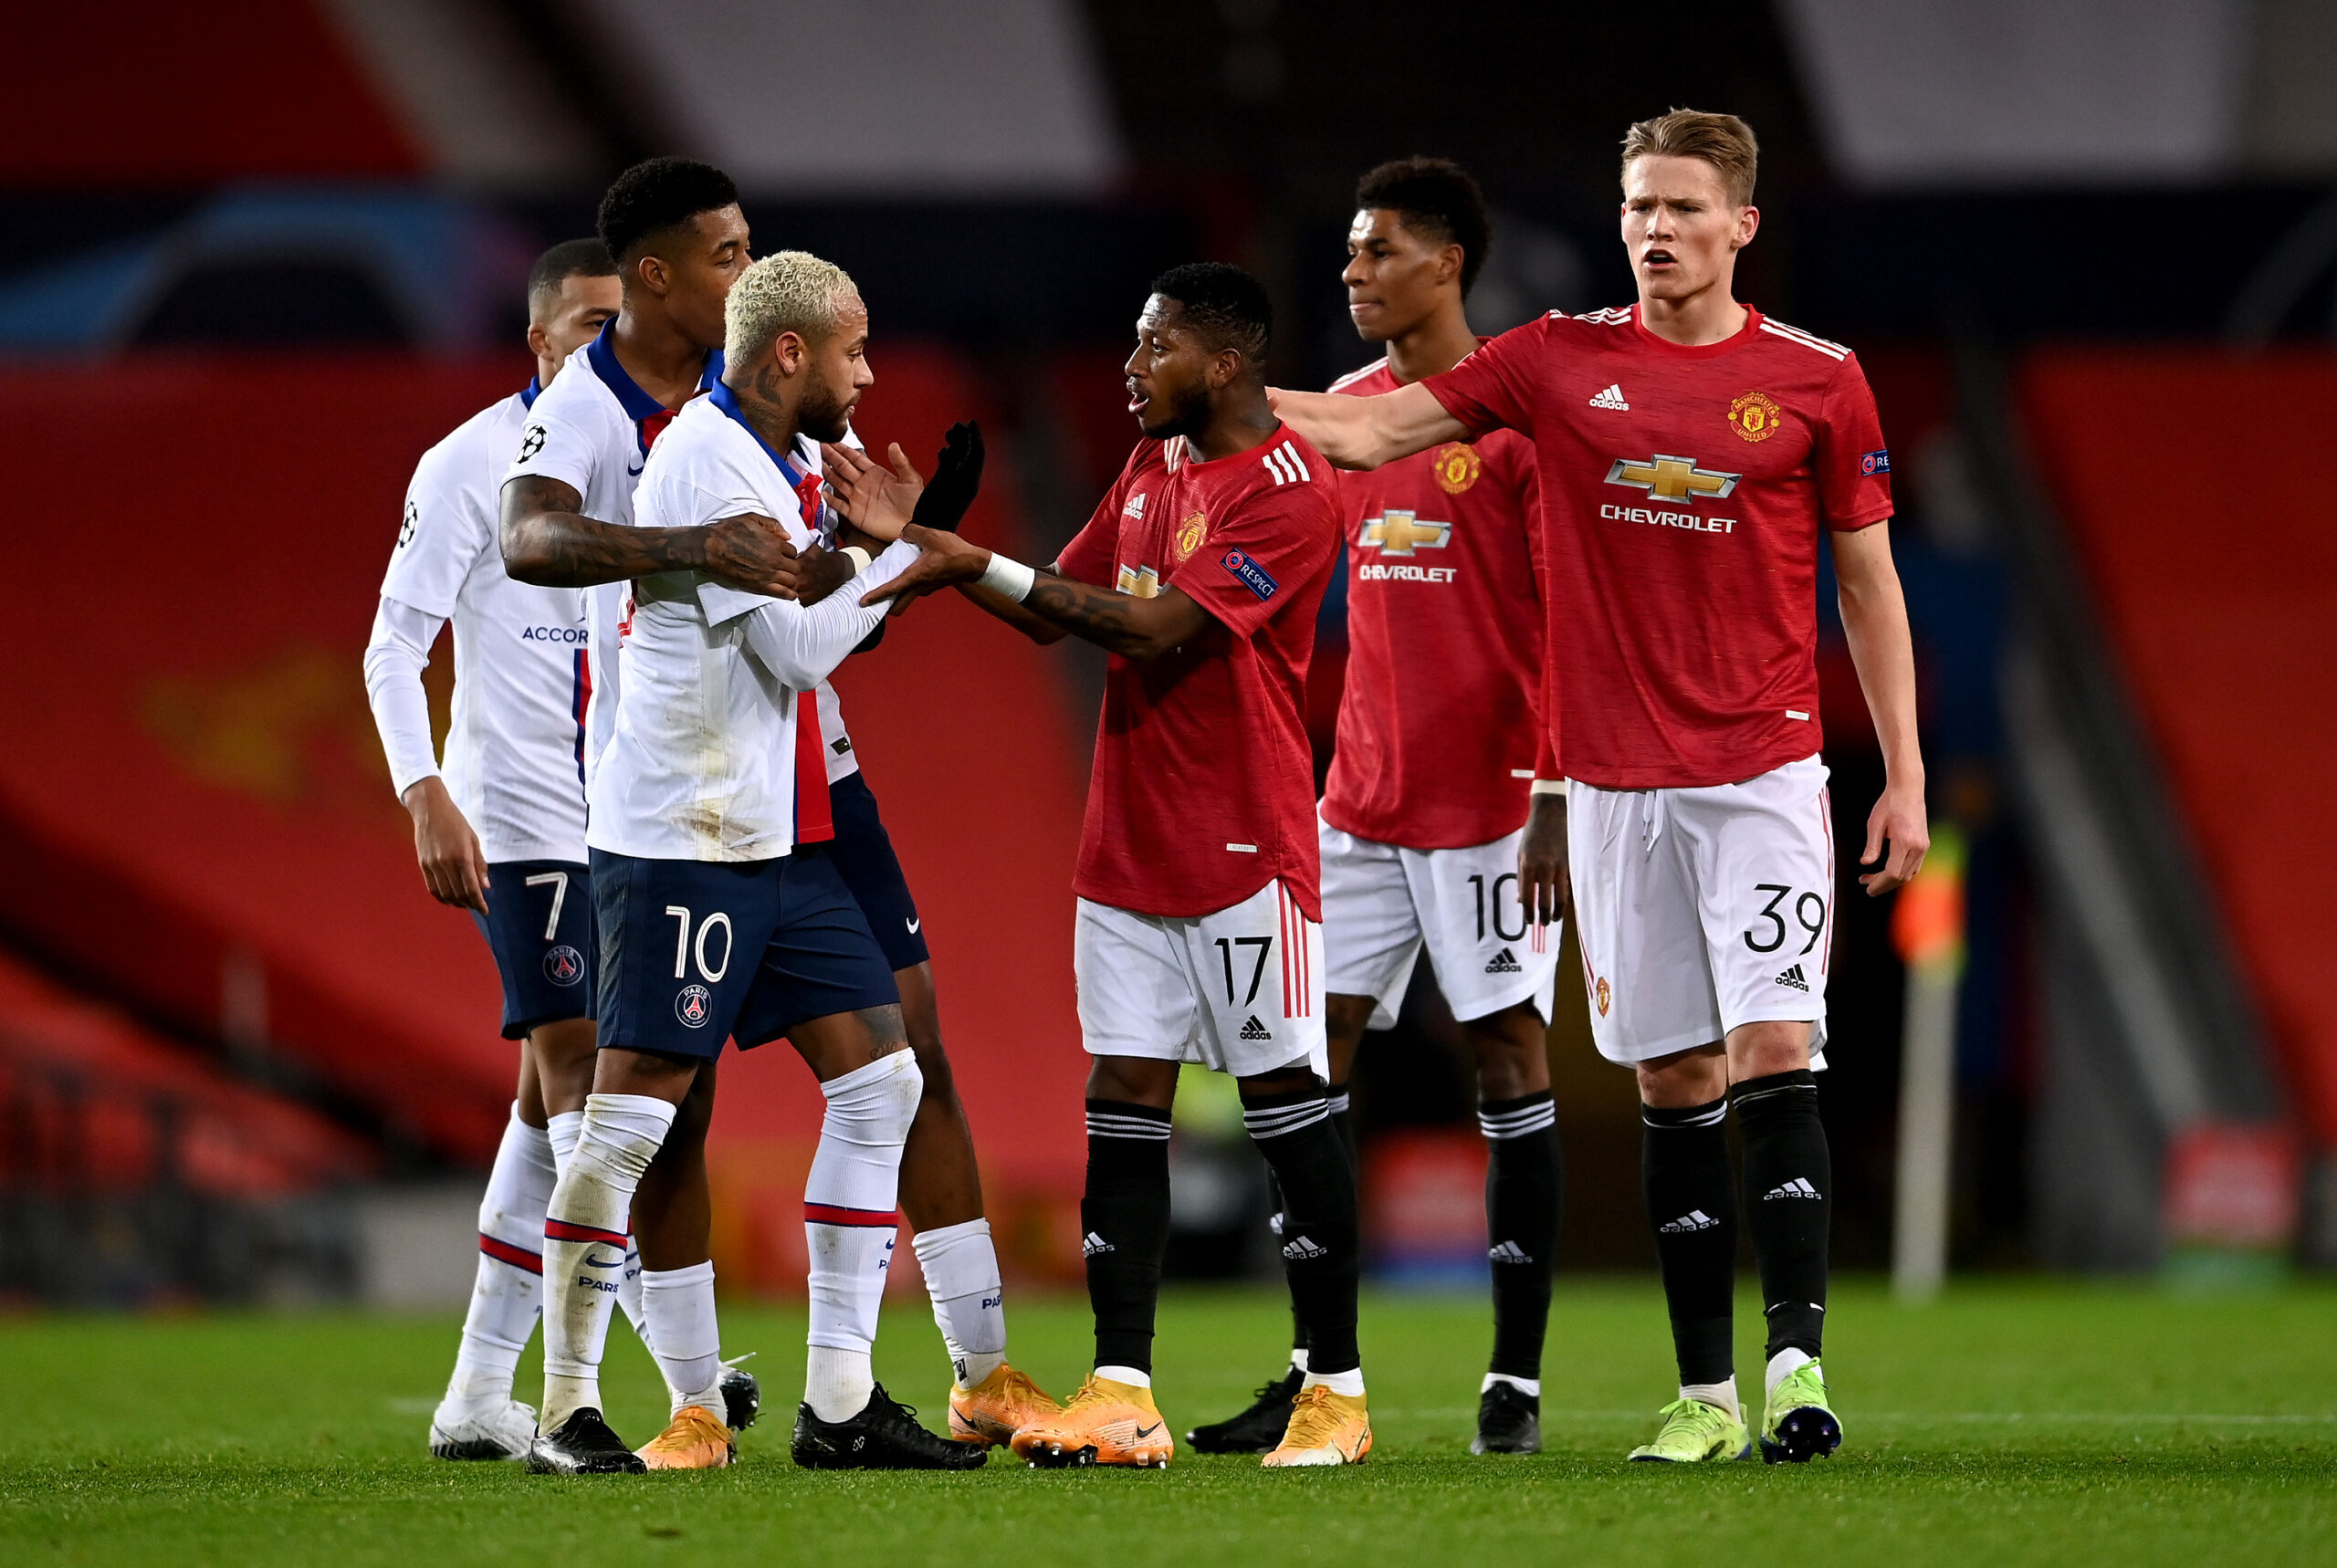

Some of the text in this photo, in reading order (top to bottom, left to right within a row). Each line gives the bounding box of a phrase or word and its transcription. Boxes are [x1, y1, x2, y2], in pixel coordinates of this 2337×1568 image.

[1588, 398, 1630, 411] adidas
[1737, 428, 1767, 439] UNITED
[1600, 504, 1737, 533] CHEVROLET
[1241, 564, 1274, 596] RESPECT
[1359, 564, 1457, 583] CHEVROLET
[522, 626, 589, 643] ACCOR
[526, 871, 569, 941] 7
[1467, 873, 1526, 943] 10
[1744, 883, 1825, 956] 39
[665, 904, 733, 983] 10
[1214, 936, 1273, 1008] 17
[1484, 964, 1523, 974] adidas
[684, 987, 708, 999] PARIS
[1775, 976, 1809, 993] adidas
[1240, 1030, 1272, 1040] adidas
[1763, 1189, 1822, 1200] adidas
[1660, 1218, 1720, 1233] adidas
[1283, 1247, 1327, 1260] adidas
[578, 1275, 619, 1293] PARIS
